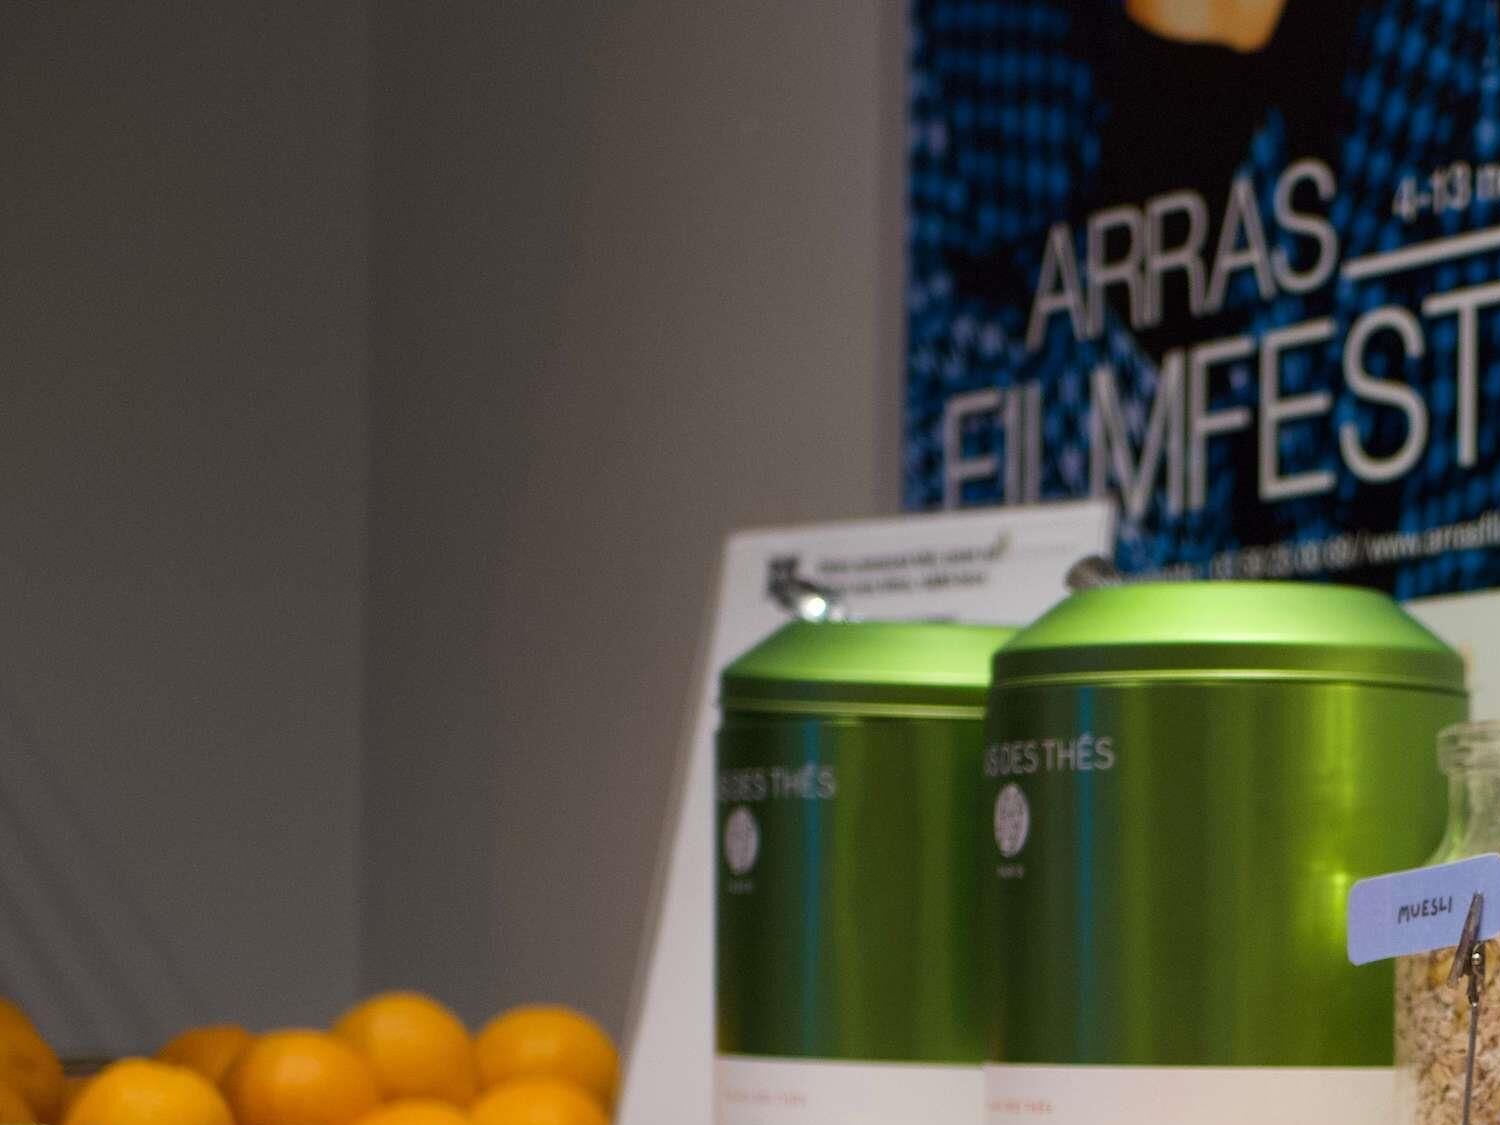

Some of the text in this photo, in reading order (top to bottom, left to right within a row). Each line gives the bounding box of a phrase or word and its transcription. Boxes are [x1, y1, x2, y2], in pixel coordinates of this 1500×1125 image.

[1393, 162, 1471, 223] 4-13
[1024, 157, 1339, 351] ARRAS
[1398, 895, 1453, 925] MUESLI
